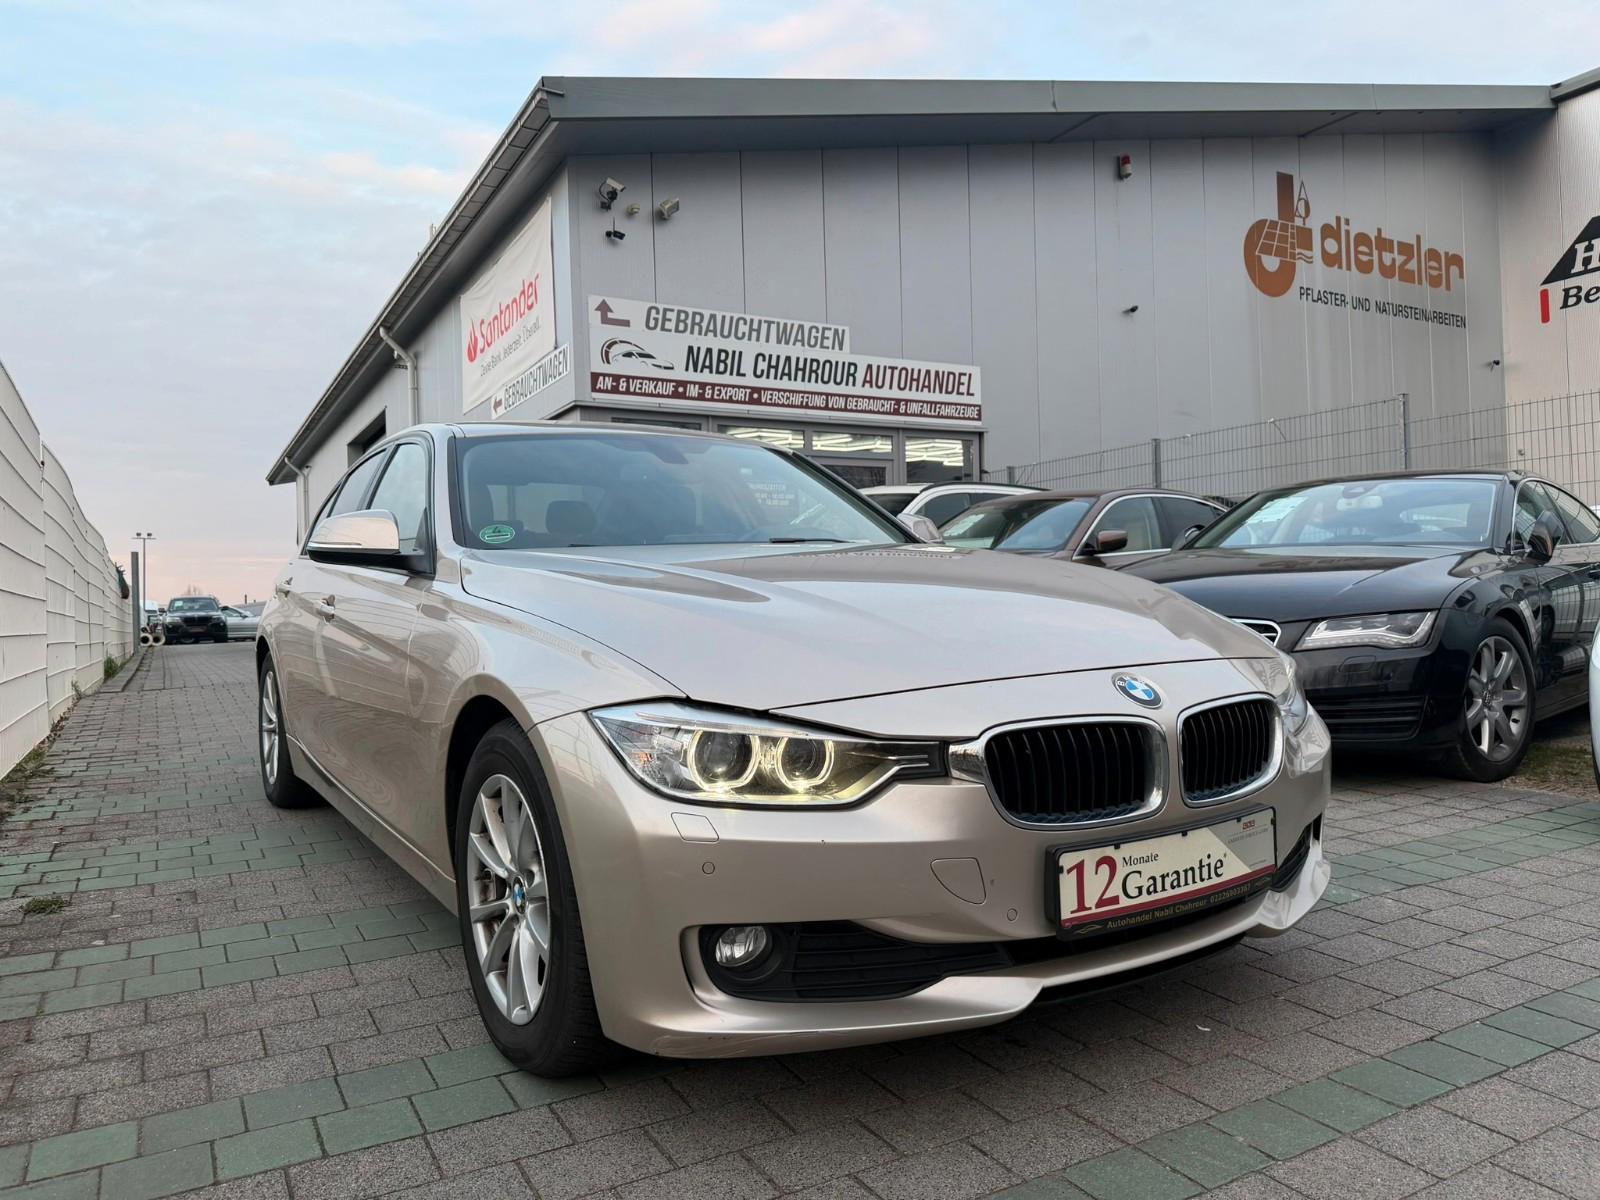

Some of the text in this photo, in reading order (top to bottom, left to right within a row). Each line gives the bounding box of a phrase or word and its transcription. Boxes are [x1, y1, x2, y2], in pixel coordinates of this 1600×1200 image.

[1320, 215, 1465, 292] dietzler
[479, 273, 540, 354] Santander
[645, 305, 846, 351] GEBRAUCHTWAGEN
[1299, 286, 1467, 329] PFLASTER- UND NATURSTEINARBEITEN
[503, 346, 569, 411] GEBRAUCHTWAGEN
[684, 345, 976, 397] NABIL CHAHROUR AUTOHANDEL
[596, 376, 980, 419] AN- & VERKAUF IM- & EXPORT VERSCHIFFUNG VON GEBRAUCHT- & UNFALLFAHRZEUGE
[1122, 852, 1159, 868] Monate
[1066, 855, 1121, 915] 12
[1107, 911, 1153, 929] Autohandel
[1154, 907, 1174, 920] Nabil
